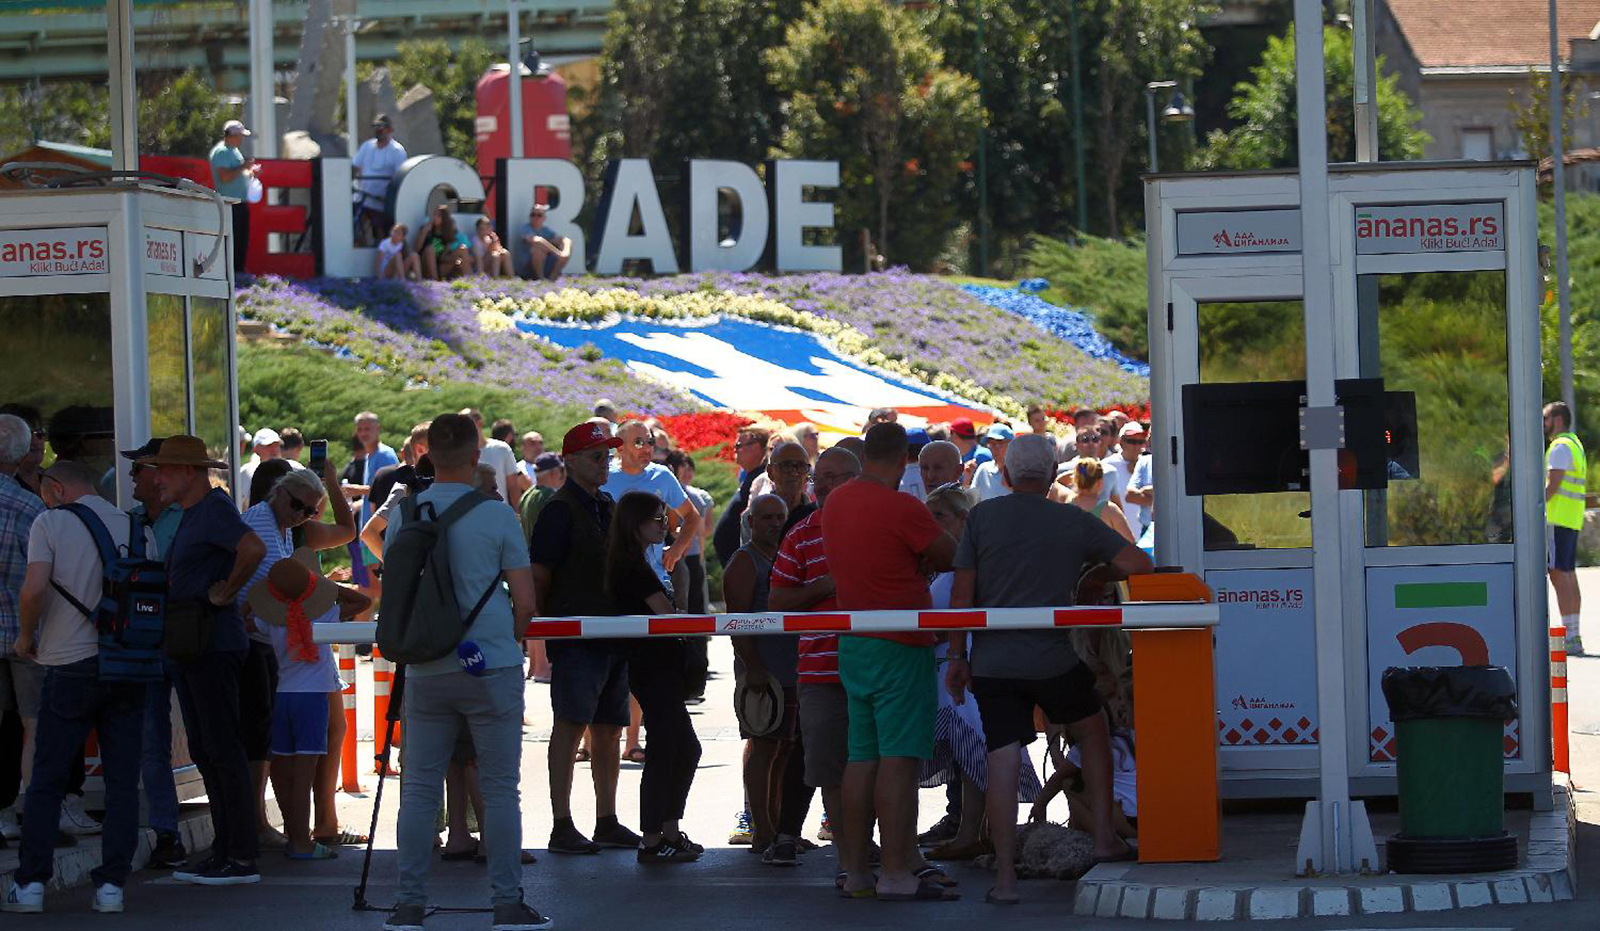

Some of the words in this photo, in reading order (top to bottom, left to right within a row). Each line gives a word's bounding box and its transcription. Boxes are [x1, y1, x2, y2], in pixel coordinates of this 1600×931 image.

[140, 157, 843, 281] ELGRADE
[1420, 239, 1443, 250] Klik!
[1446, 237, 1470, 249] Buć!
[1472, 236, 1498, 248] Ada!
[30, 262, 52, 274] Klik!
[55, 261, 79, 272] Buć!
[81, 260, 105, 272] Ada!
